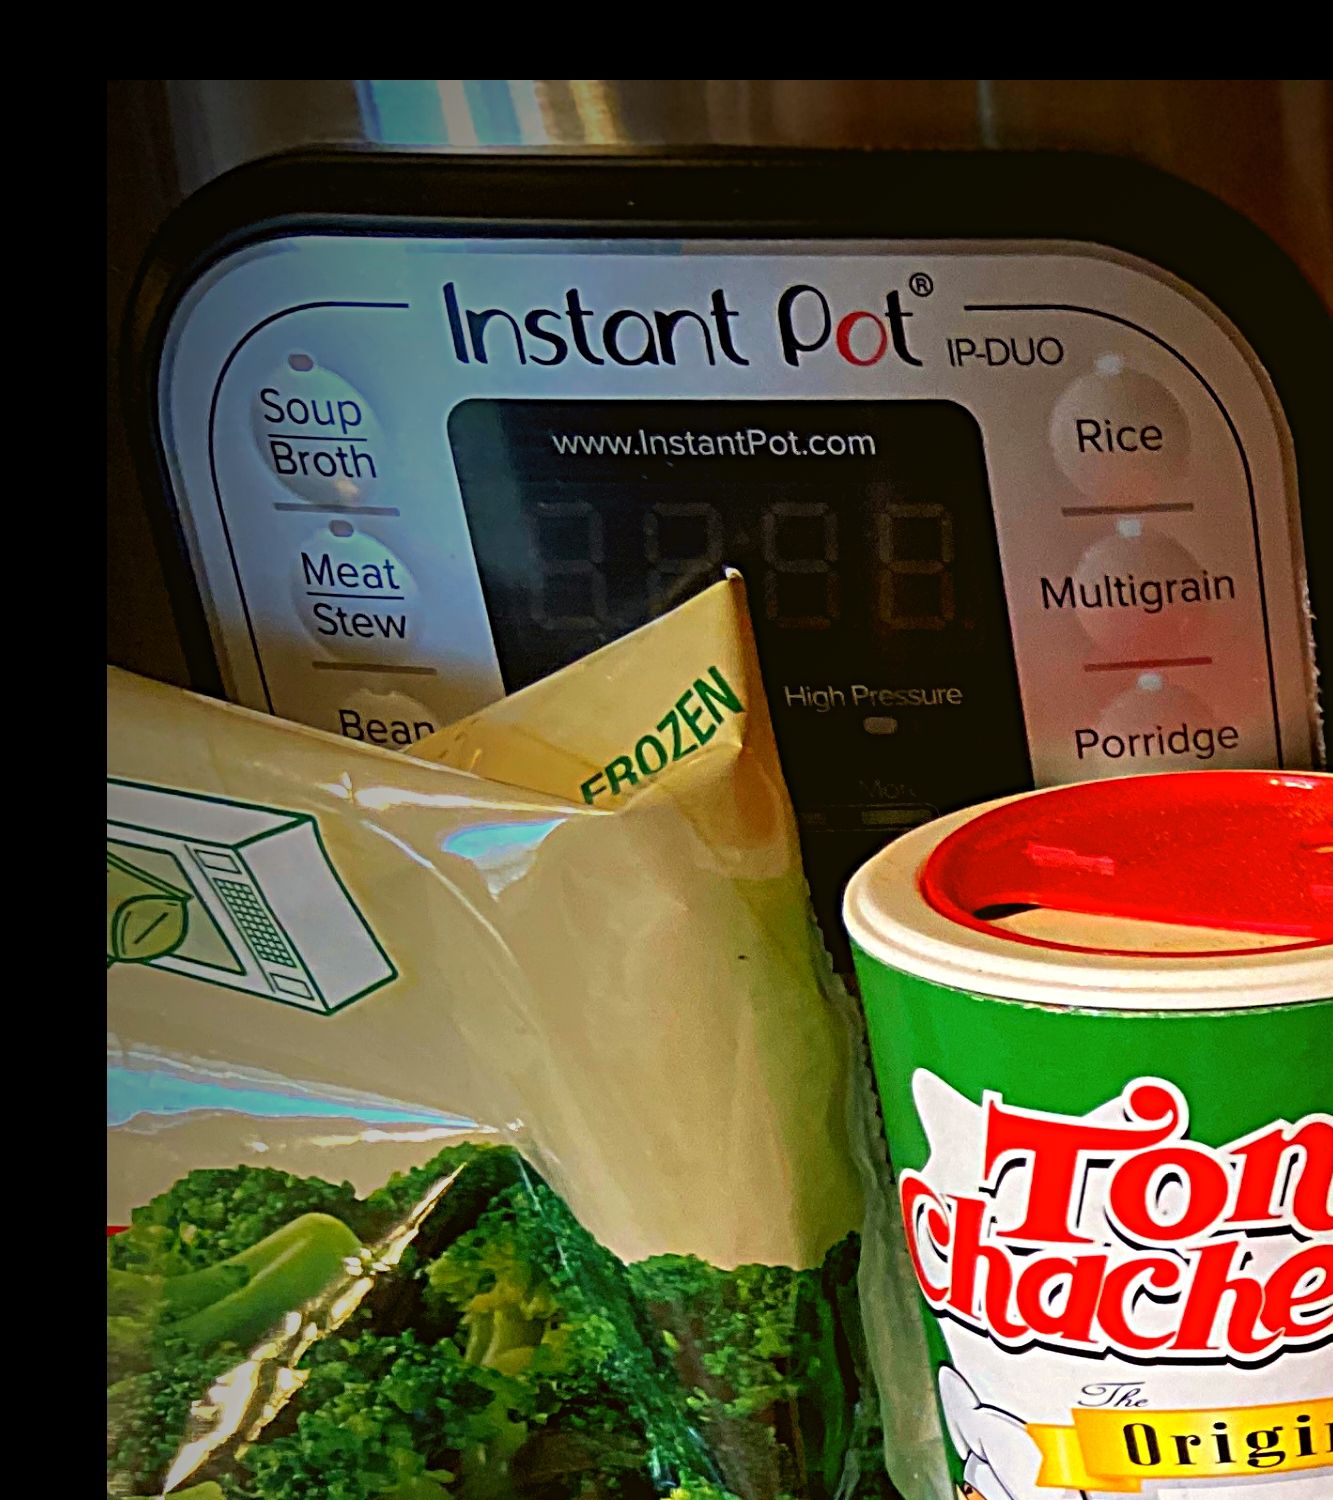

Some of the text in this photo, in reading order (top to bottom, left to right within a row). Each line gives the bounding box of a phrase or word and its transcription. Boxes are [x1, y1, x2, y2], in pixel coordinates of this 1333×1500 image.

[444, 283, 923, 367] Instant Pot
[947, 336, 1064, 367] IP-DUO
[260, 388, 362, 429] Soup
[553, 429, 876, 457] www.InstantPot.com
[1075, 418, 1163, 452] Rice
[272, 440, 376, 479] Broth
[302, 553, 400, 591] Meat
[1040, 570, 1235, 614] Multigrain
[313, 603, 407, 639] Stew
[784, 685, 964, 712] High Pressure
[580, 665, 747, 805] FROZEN
[1075, 724, 1239, 771] Porridge
[1078, 1382, 1148, 1409] The
